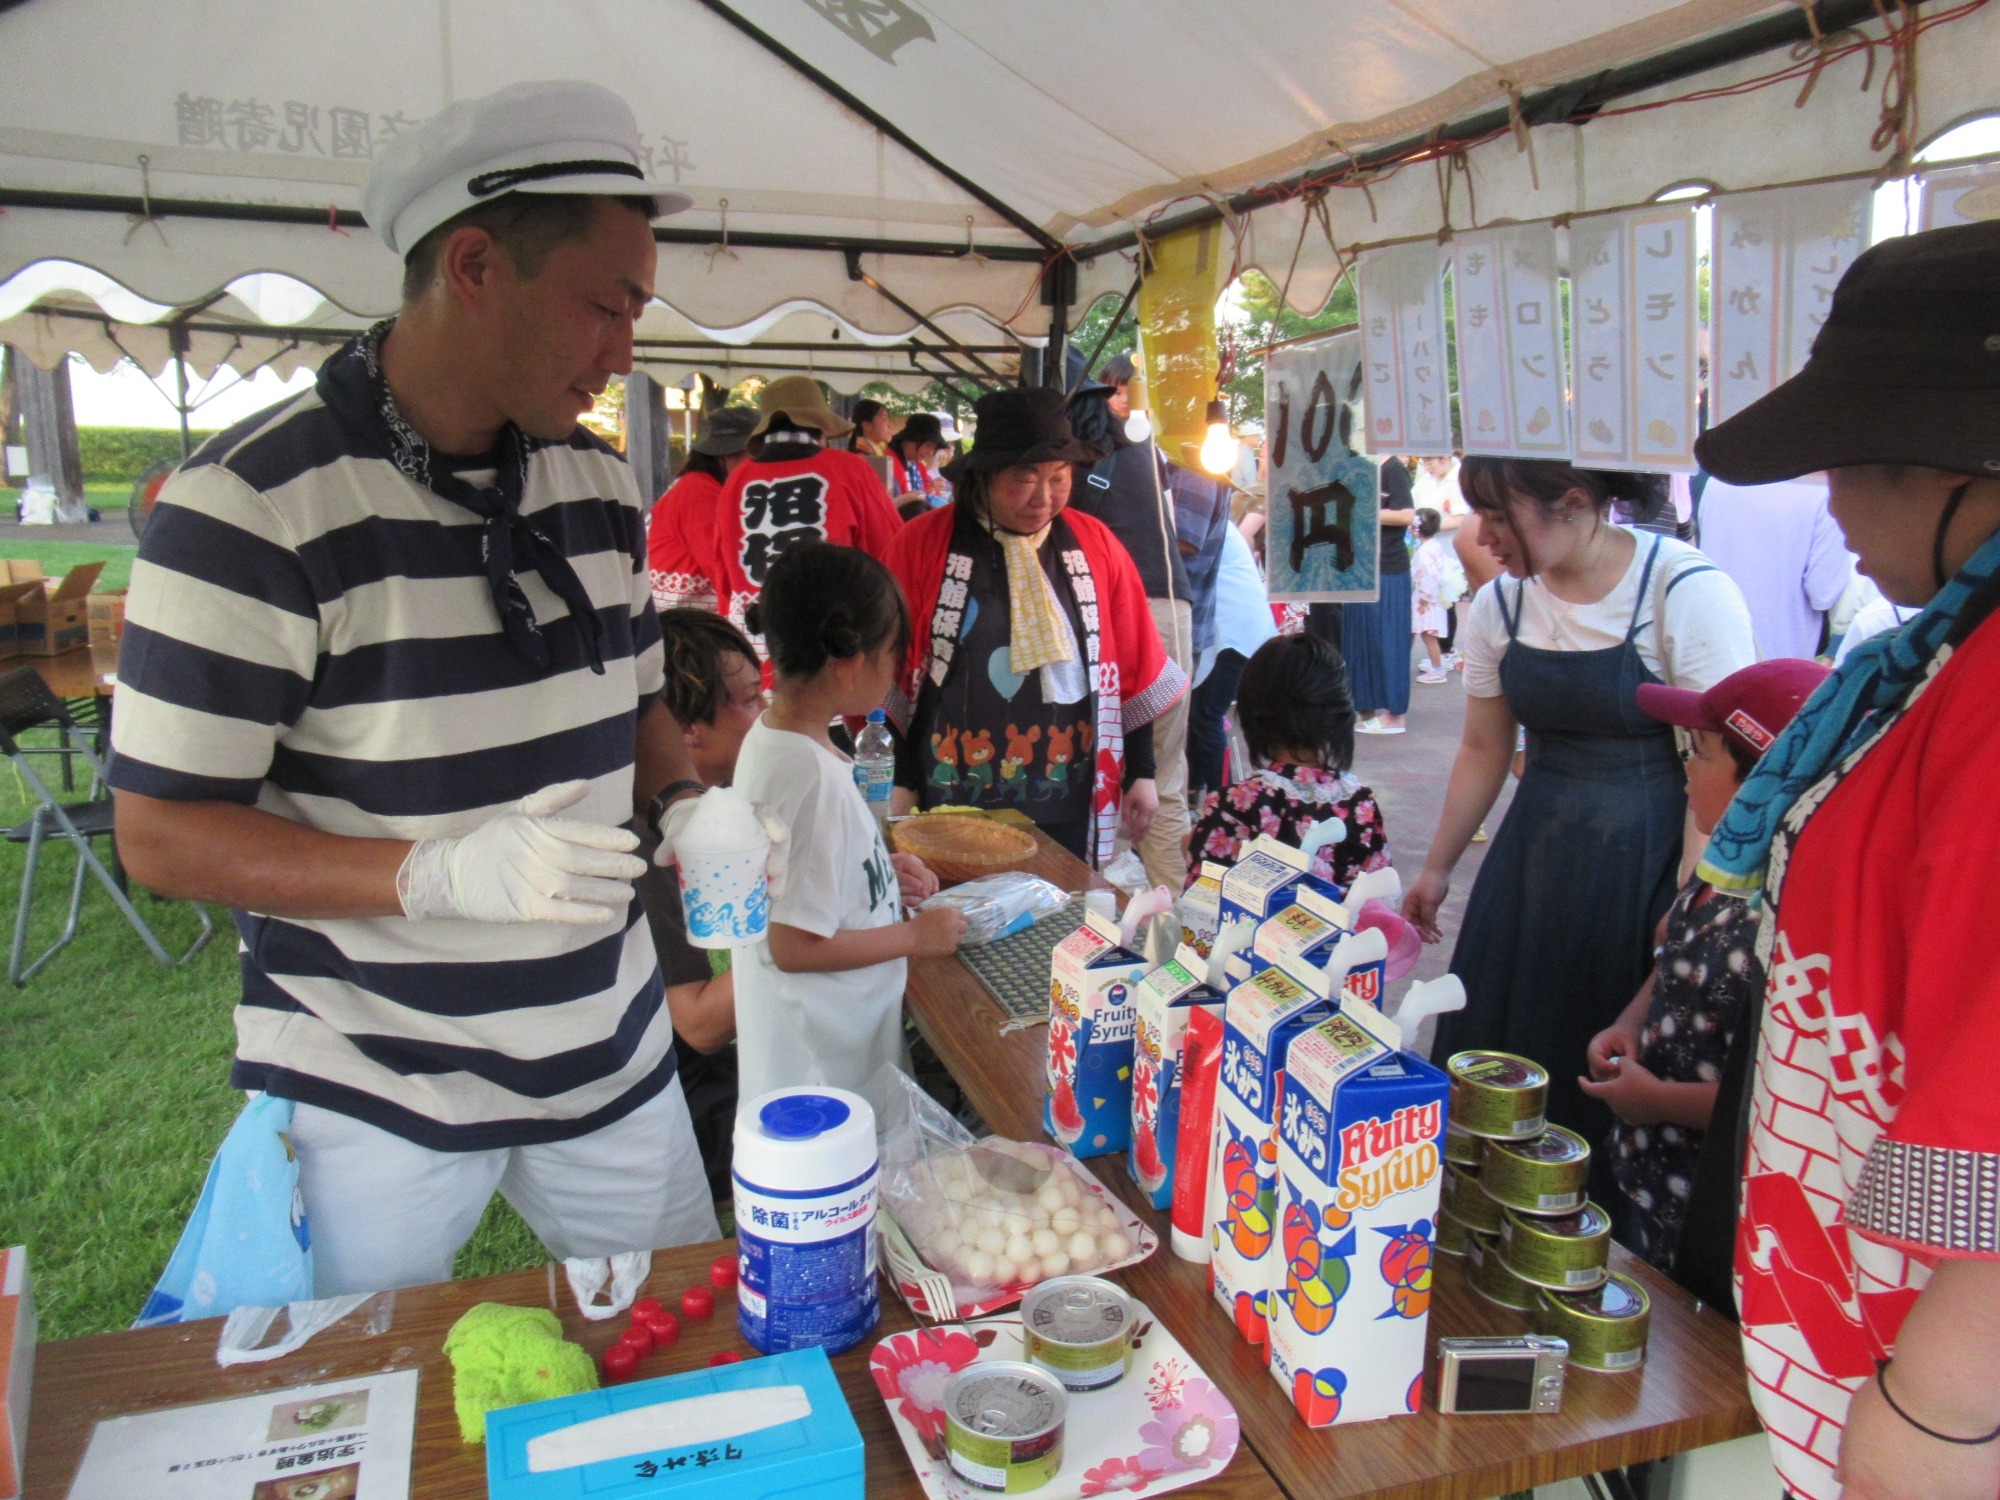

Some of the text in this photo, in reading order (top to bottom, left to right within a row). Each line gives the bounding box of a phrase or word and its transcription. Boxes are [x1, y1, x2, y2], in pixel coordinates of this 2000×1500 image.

[1286, 478, 1357, 574] 円
[1283, 1092, 1327, 1171] 氷みつ
[1340, 1100, 1442, 1169] Fruity
[1335, 1142, 1438, 1212] Syrup
